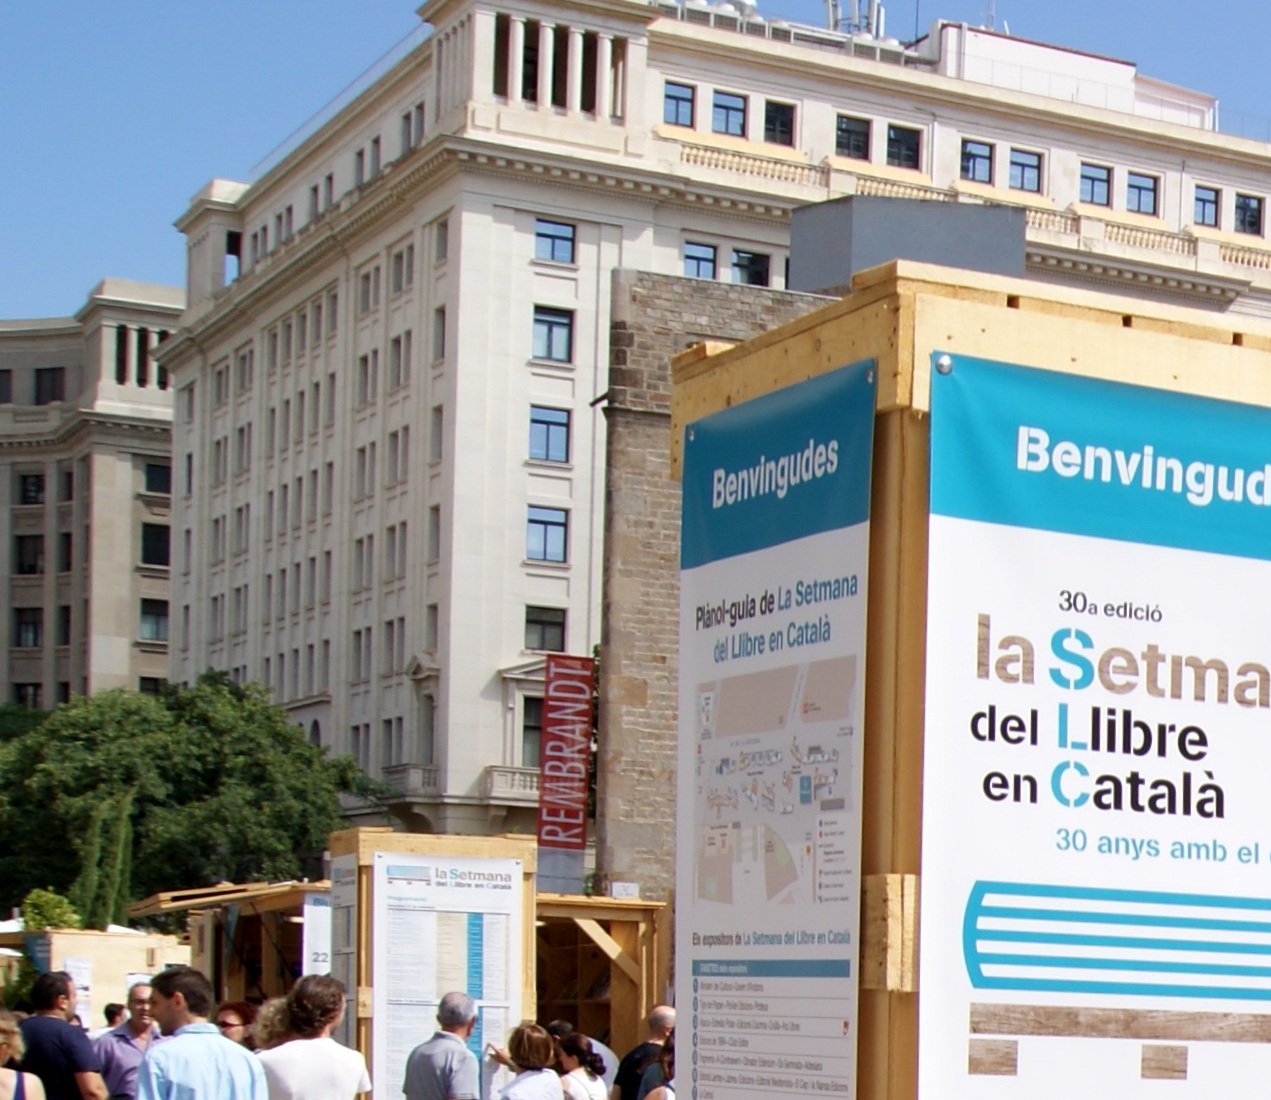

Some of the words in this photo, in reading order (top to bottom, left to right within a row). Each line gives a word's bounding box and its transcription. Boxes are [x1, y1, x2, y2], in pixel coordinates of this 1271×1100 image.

[712, 437, 839, 508] Benvingudes
[696, 593, 756, 631] Plànol-guia
[759, 589, 775, 615] de
[778, 585, 792, 611] La
[795, 573, 858, 607] Setmana
[1103, 599, 1162, 623] edició
[713, 636, 729, 664] del
[731, 631, 766, 659] Llibre
[769, 629, 783, 652] en
[787, 614, 831, 648] Català
[976, 613, 1035, 685] la
[541, 661, 591, 844] REMBRANDT
[970, 705, 1039, 745] del
[1057, 703, 1209, 761] Llibre
[982, 770, 1038, 803] en
[1050, 760, 1226, 819] Català
[1055, 828, 1087, 853] 30
[1097, 833, 1160, 861] anys
[1170, 838, 1228, 864] amb
[1237, 841, 1260, 866] el
[435, 867, 447, 879] la
[449, 868, 512, 882] Setmana
[312, 952, 329, 963] 22
[752, 931, 782, 944] Setmana
[783, 931, 795, 945] del
[796, 930, 815, 944] Llibre
[817, 933, 826, 944] en
[827, 929, 850, 944] Català
